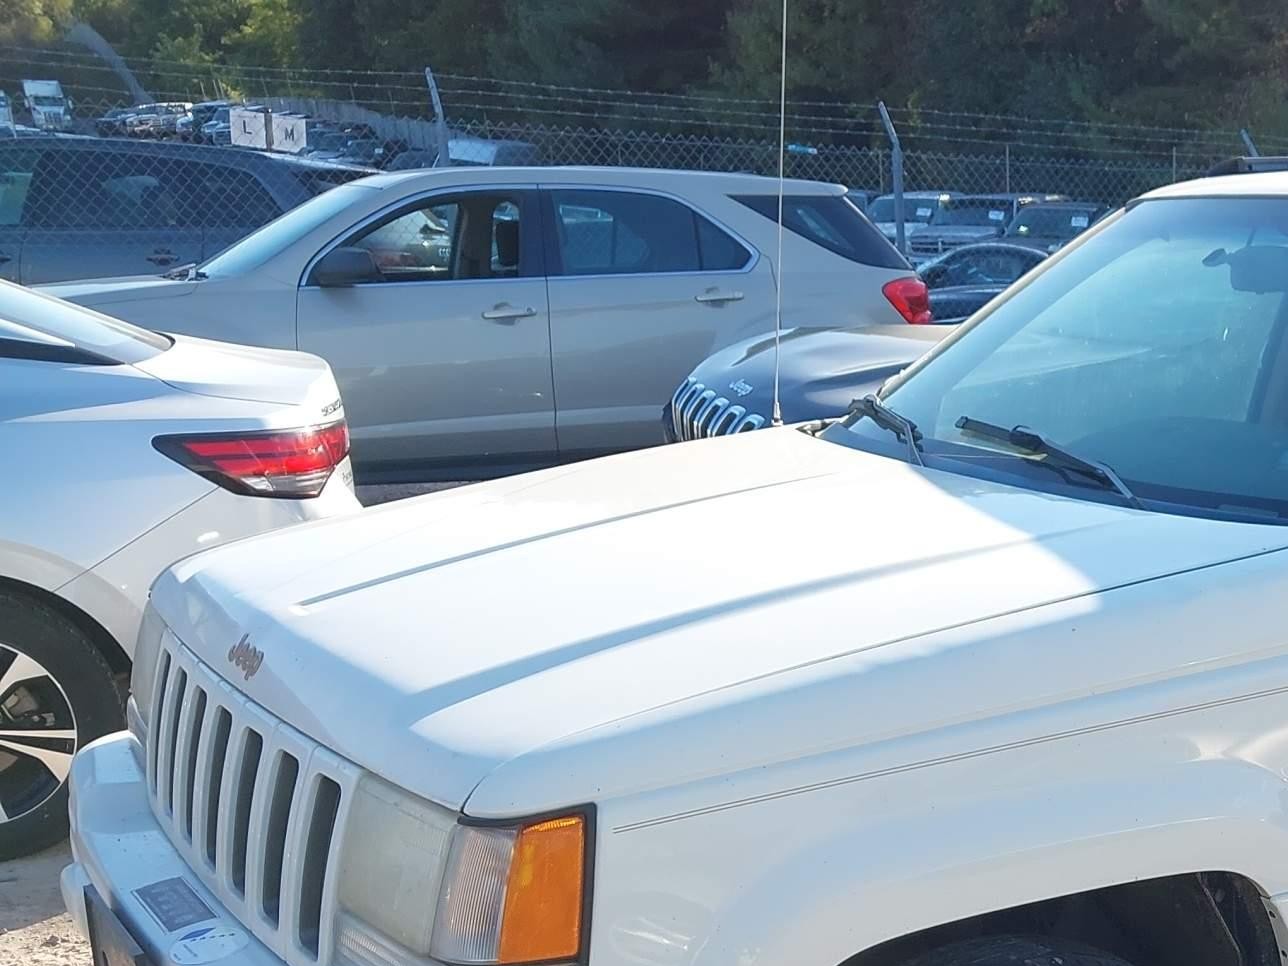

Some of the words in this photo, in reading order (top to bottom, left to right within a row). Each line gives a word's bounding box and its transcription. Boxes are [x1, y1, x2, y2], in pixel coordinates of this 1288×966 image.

[242, 119, 253, 135] L
[284, 126, 295, 141] M
[227, 632, 265, 681] Jeep
